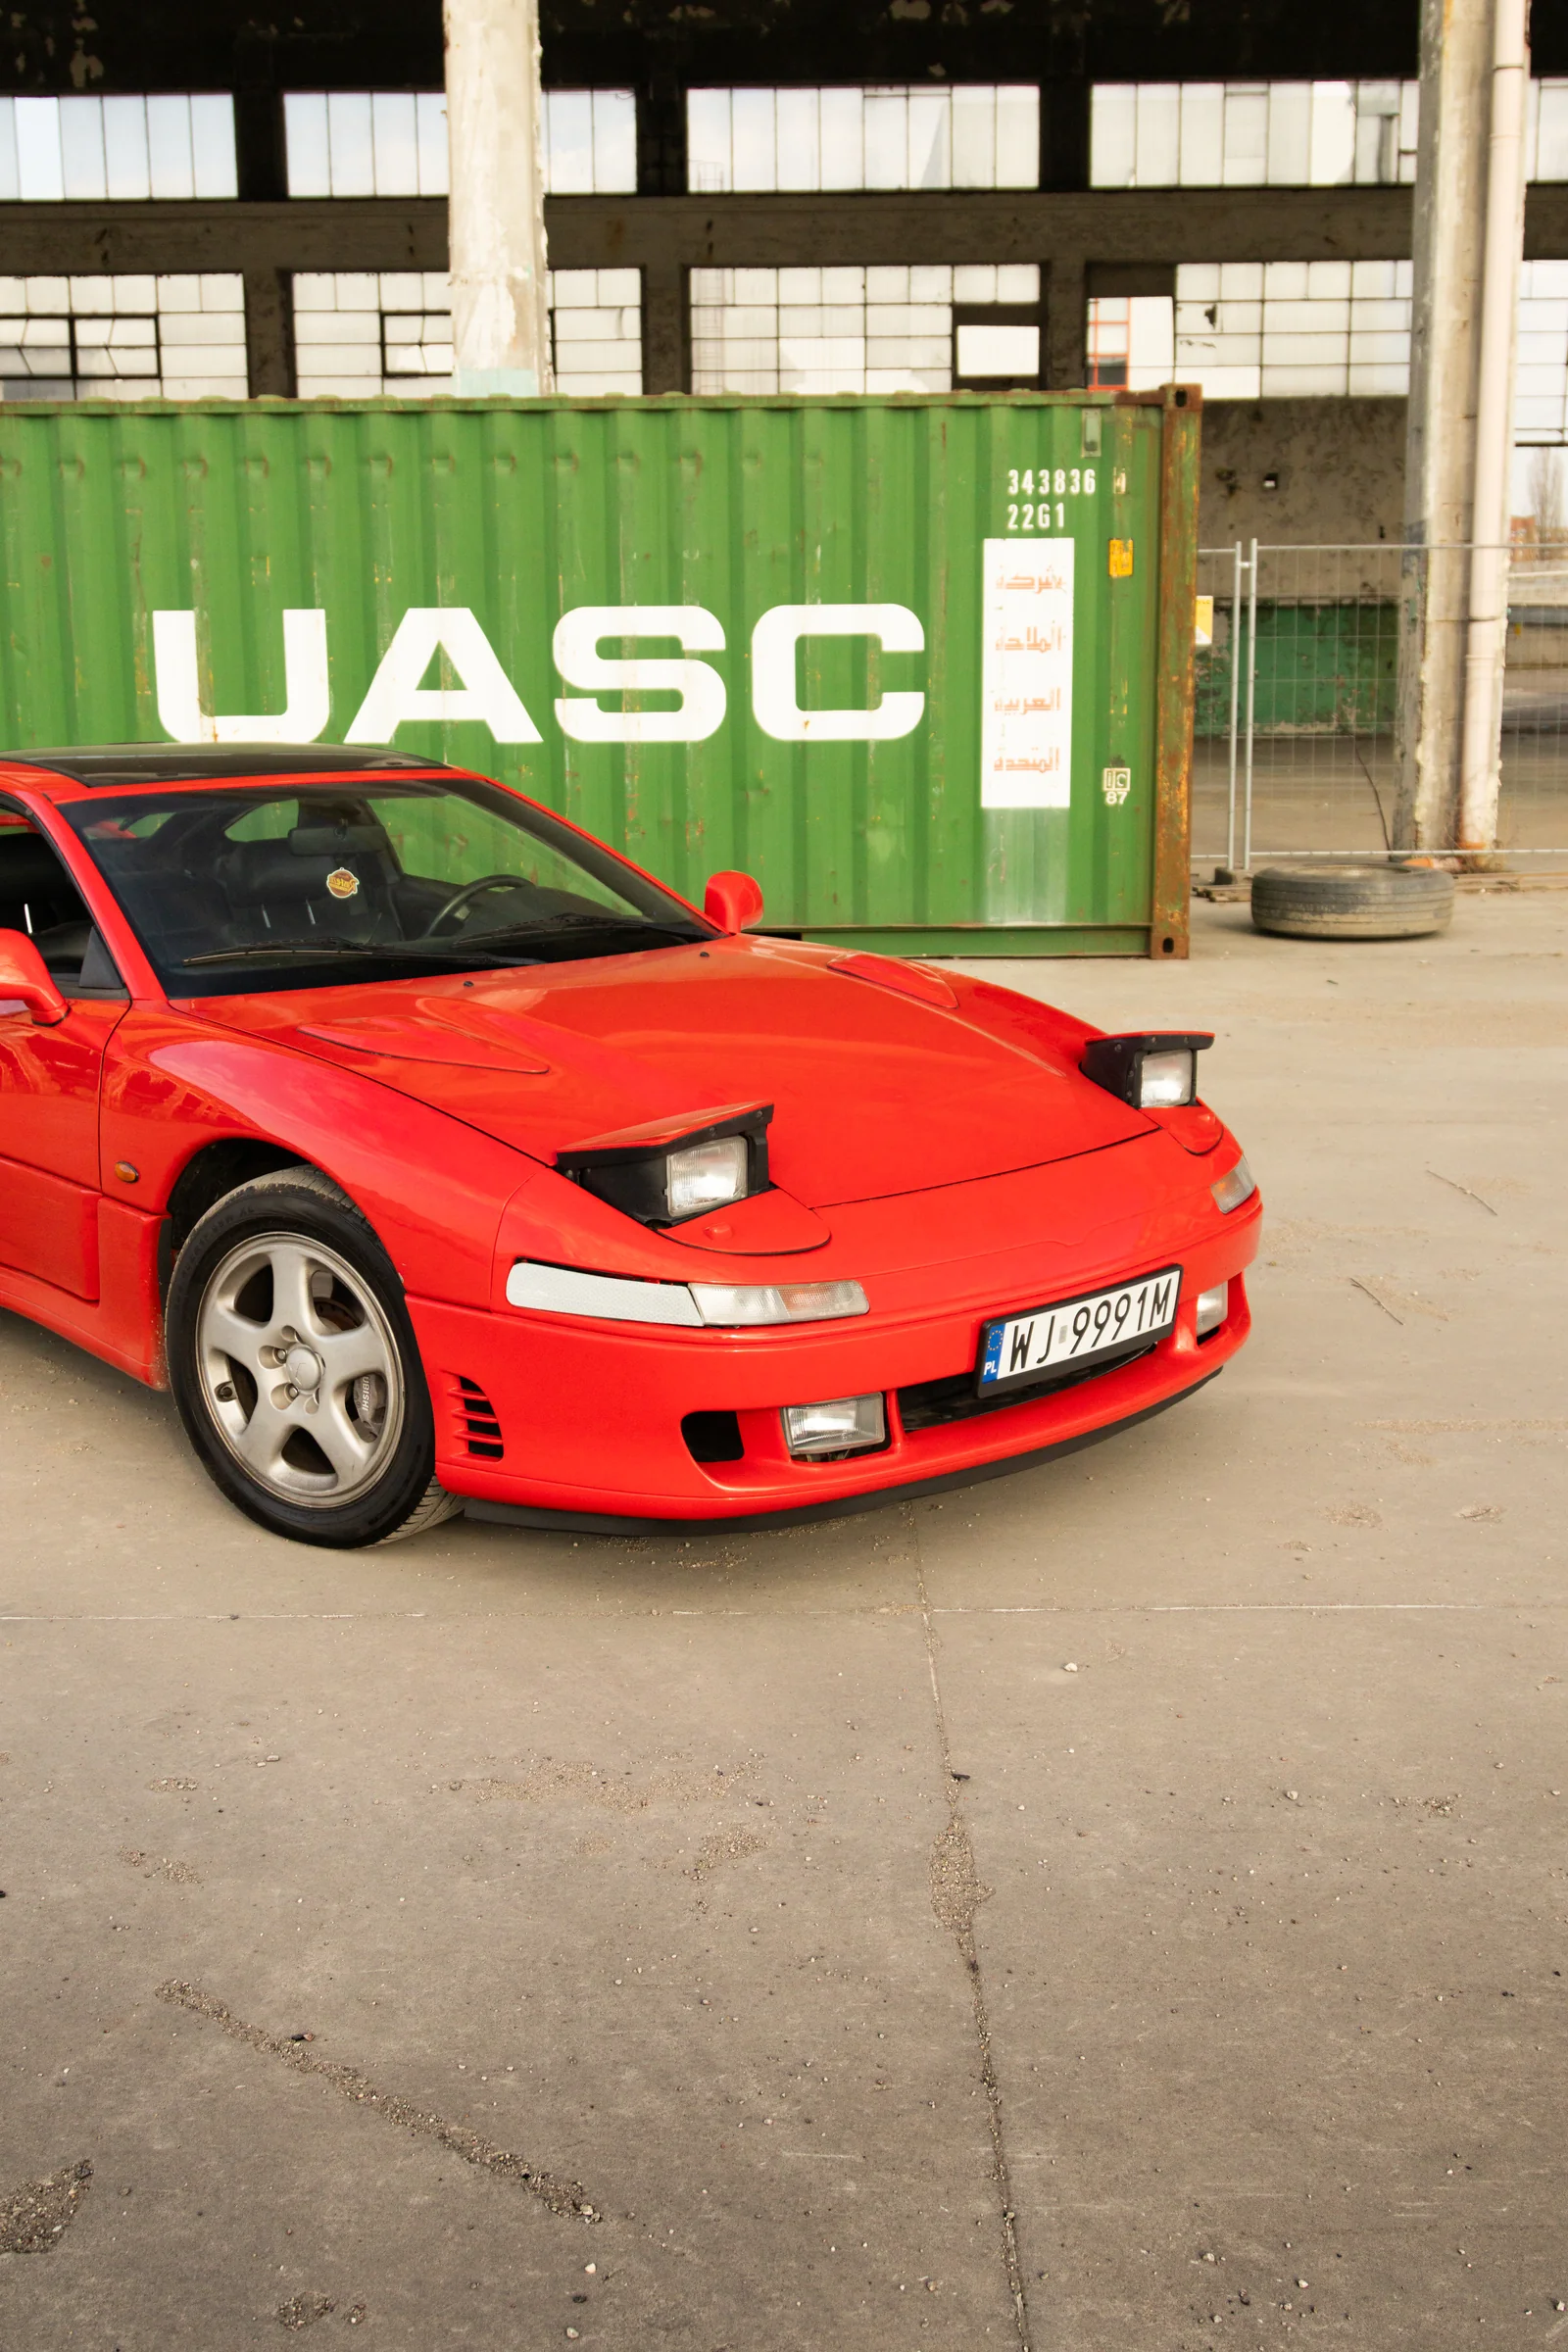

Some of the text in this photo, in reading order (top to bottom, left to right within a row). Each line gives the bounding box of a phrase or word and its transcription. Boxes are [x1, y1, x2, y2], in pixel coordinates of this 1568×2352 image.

[1007, 468, 1096, 495] 343836
[1007, 503, 1064, 529] 22G1
[152, 603, 925, 744] UASC
[1105, 791, 1128, 805] 87
[1009, 1278, 1172, 1372] WJ 9991M
[984, 1361, 998, 1376] PL
